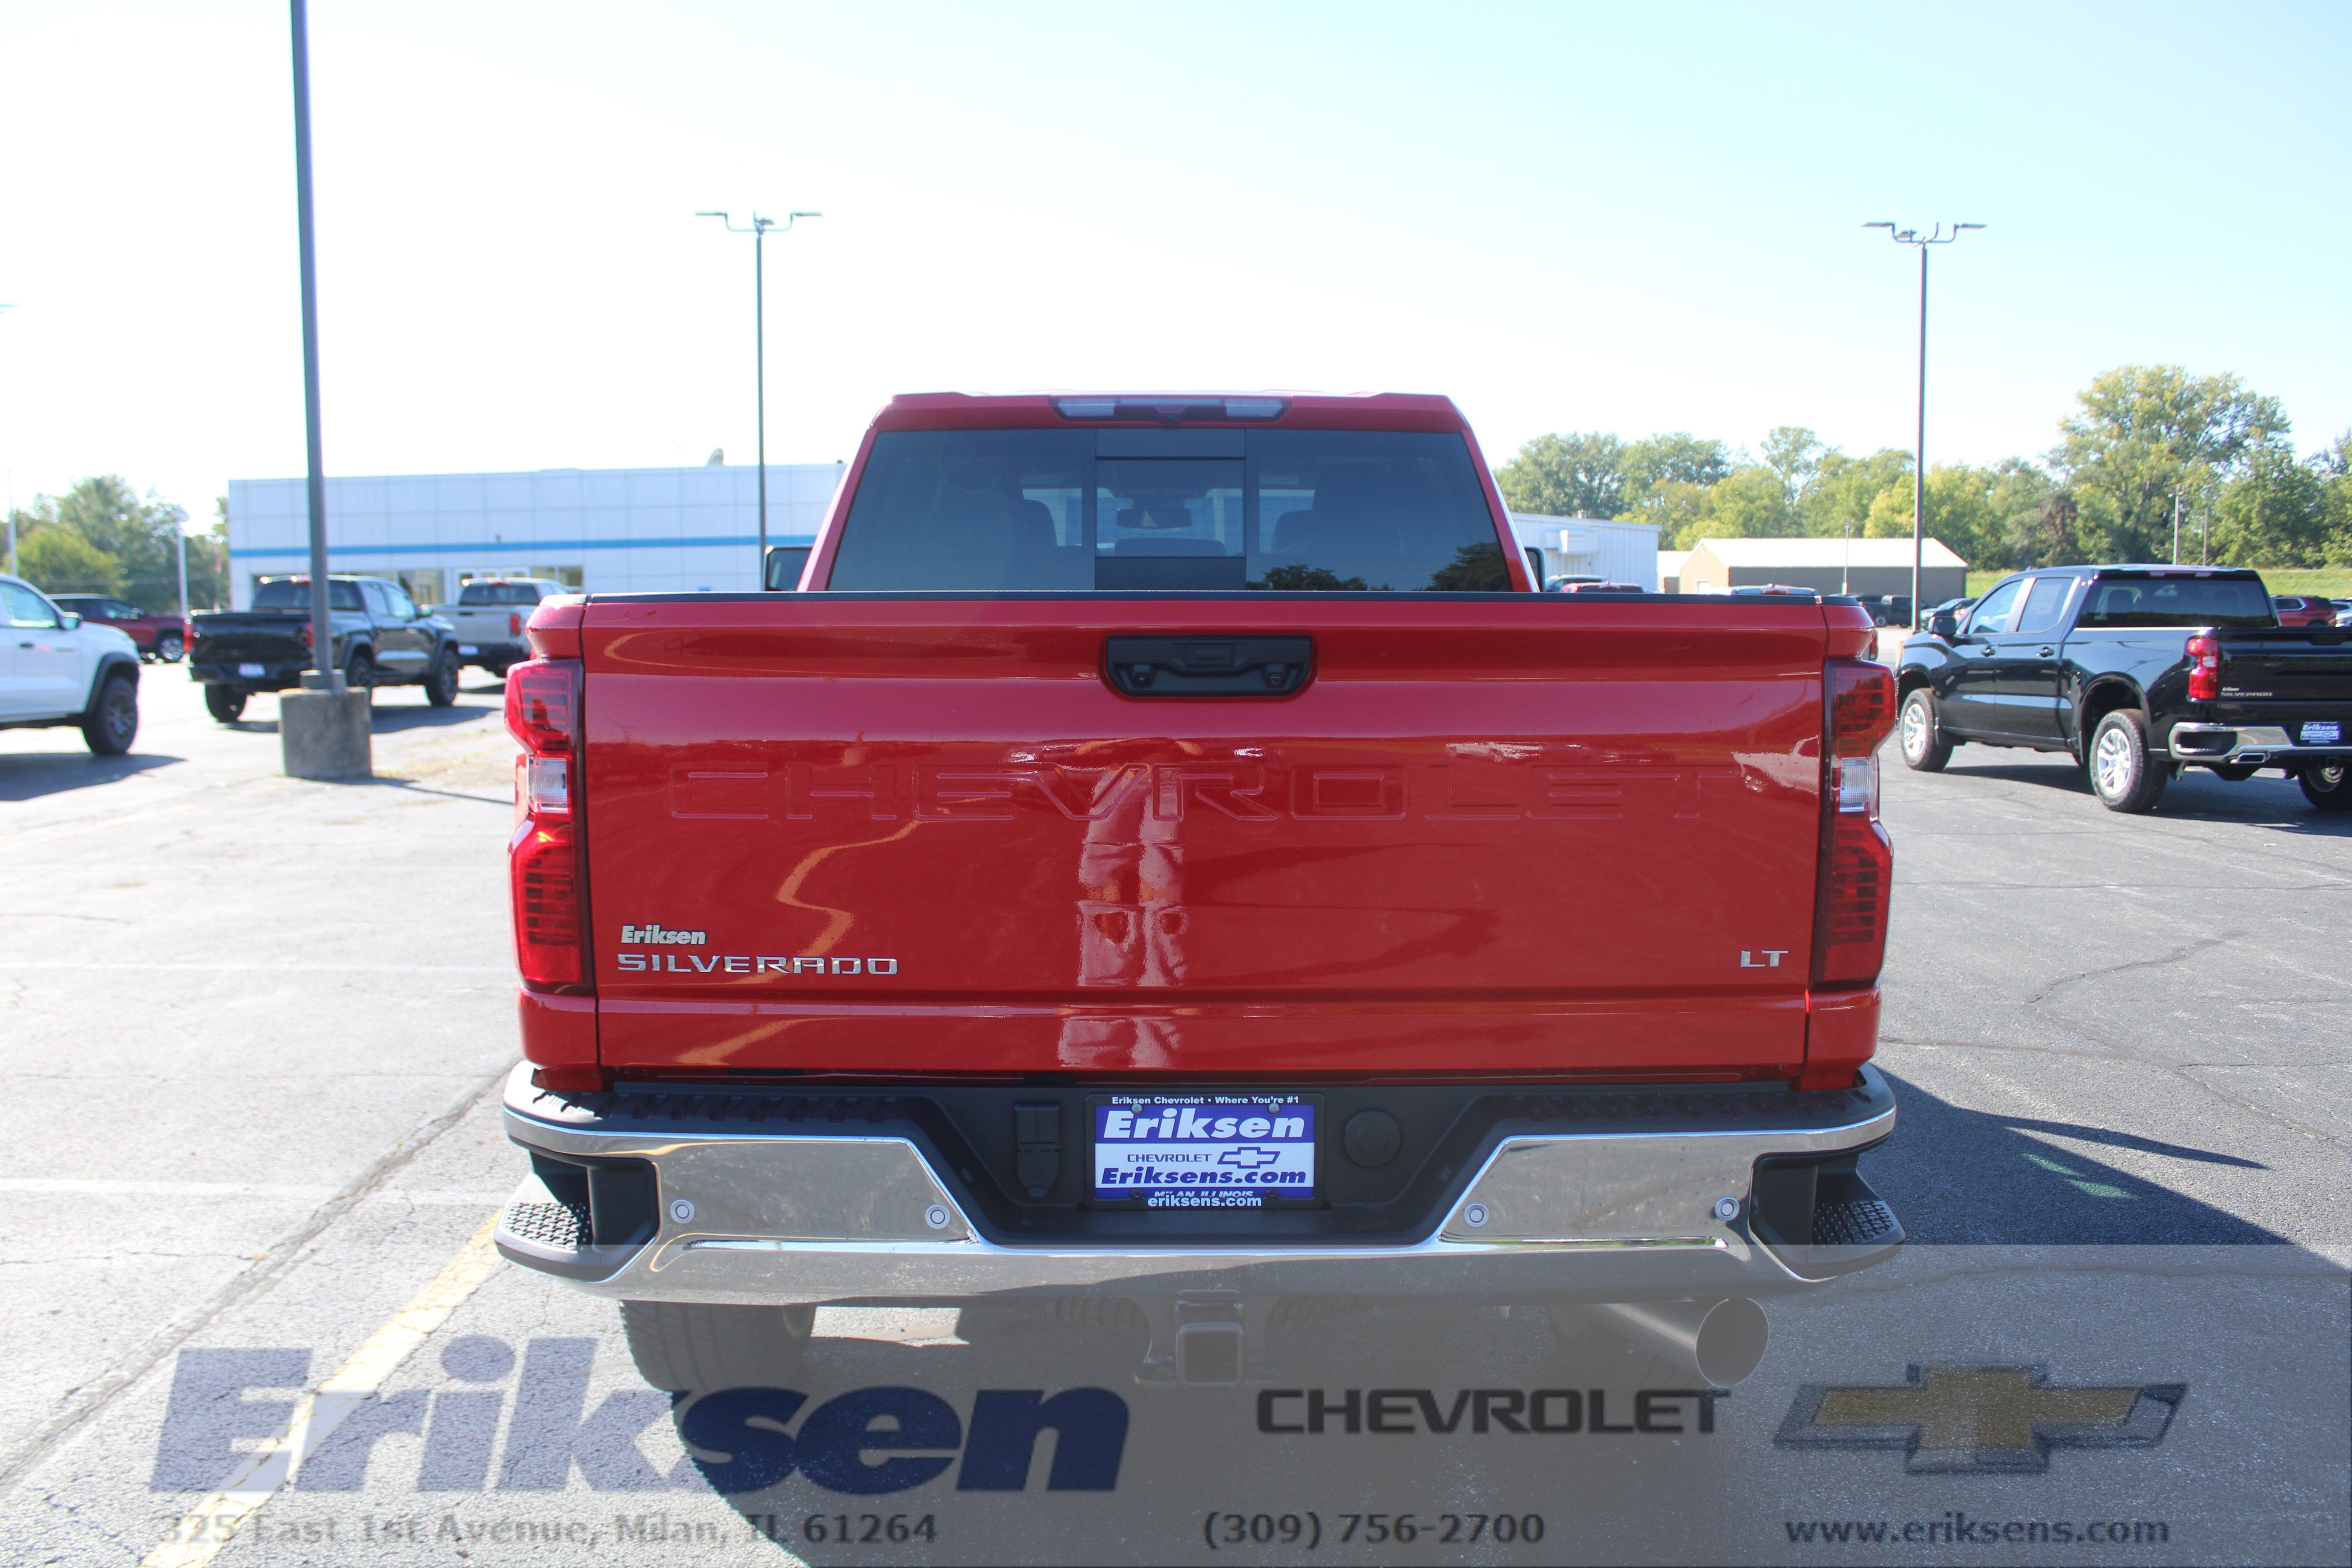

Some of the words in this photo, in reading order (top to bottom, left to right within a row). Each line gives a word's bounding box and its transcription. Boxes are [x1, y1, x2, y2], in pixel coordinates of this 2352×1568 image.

[621, 924, 706, 945] Eriksen
[617, 954, 898, 975] SILVERADO
[1741, 950, 1788, 967] LT
[1112, 1096, 1151, 1105] Eriksen
[1252, 1096, 1284, 1104] You're
[1103, 1108, 1305, 1138] Eriksen
[1127, 1154, 1212, 1162] CHEVROLET
[1101, 1167, 1306, 1184] Eriksens.com
[1148, 1195, 1262, 1207] eriksens.com
